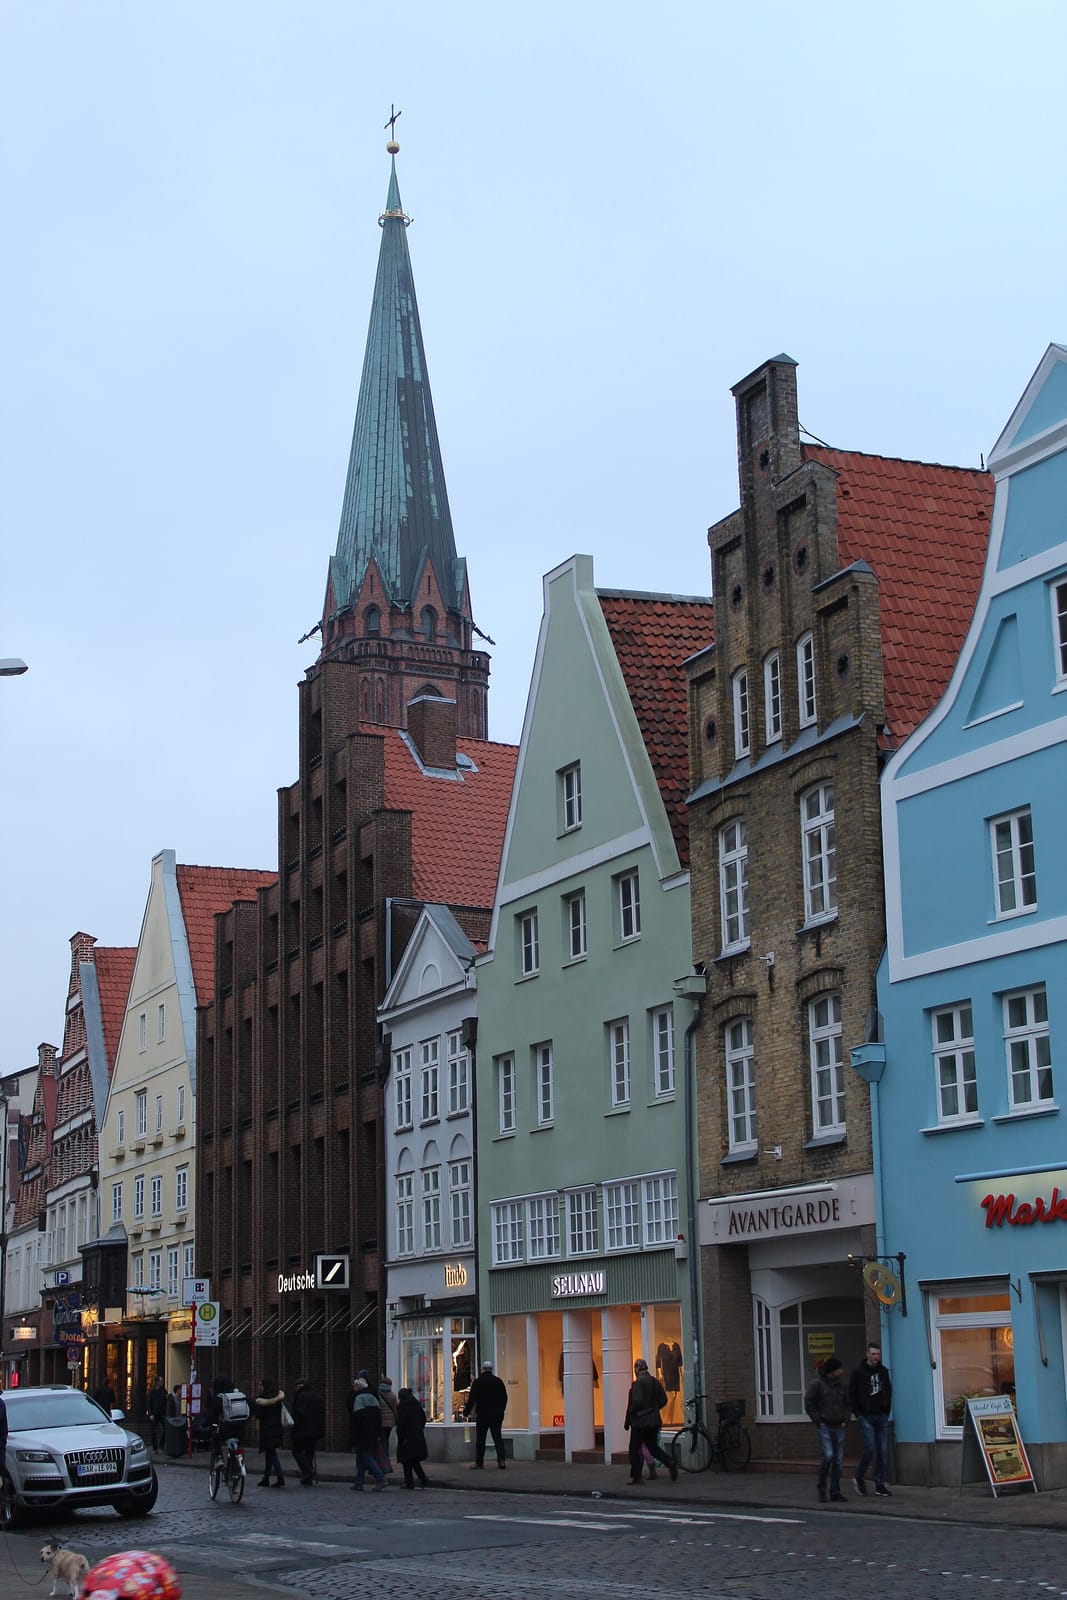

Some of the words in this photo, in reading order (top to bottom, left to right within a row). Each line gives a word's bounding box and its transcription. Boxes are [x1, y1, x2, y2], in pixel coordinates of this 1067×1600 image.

[58, 1272, 67, 1284] P
[277, 1269, 315, 1293] Deutsche
[444, 1262, 467, 1287] lindo
[553, 1273, 603, 1296] SELLNAU
[203, 1306, 212, 1318] H
